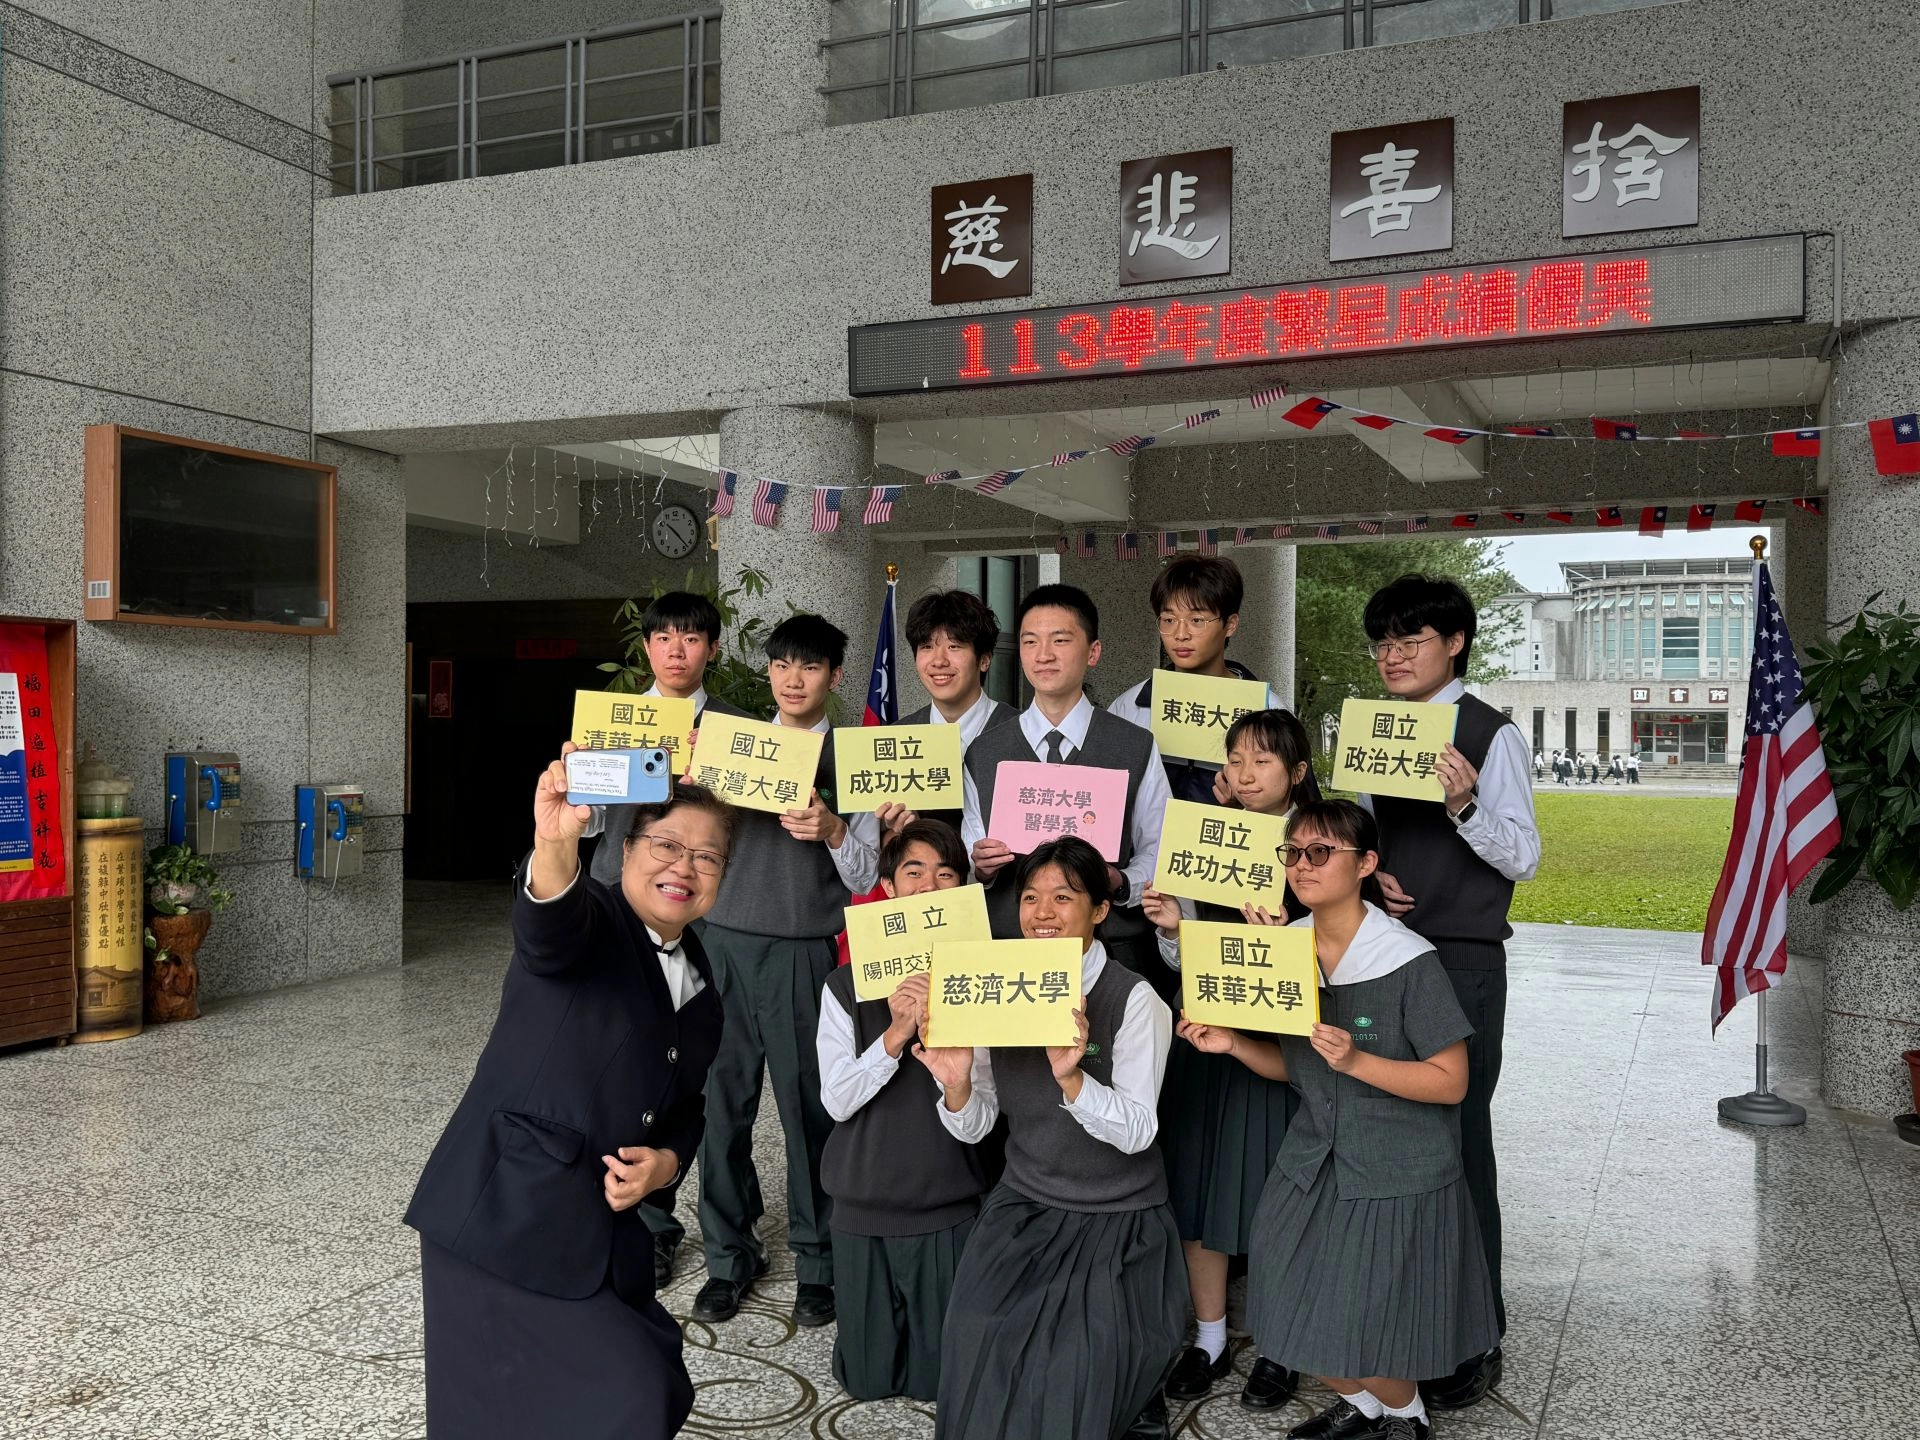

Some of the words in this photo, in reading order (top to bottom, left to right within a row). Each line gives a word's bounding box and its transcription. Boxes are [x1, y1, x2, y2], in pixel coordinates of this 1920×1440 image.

[611, 703, 658, 727] 國立
[1372, 713, 1418, 741] 國立
[730, 731, 782, 763] 國立
[873, 736, 924, 762] 國立
[1345, 746, 1438, 780] 政治大學
[697, 765, 800, 804] 臺灣大學
[849, 767, 951, 795] 成功大學
[1018, 786, 1092, 809] 慈濟大學
[1024, 812, 1078, 834] 醫學系
[1199, 818, 1251, 851] 國立
[1167, 850, 1273, 891] 成功大學
[883, 904, 948, 938] 國立
[1220, 937, 1273, 968] 國立
[942, 970, 1070, 1006] 慈濟大學
[1196, 973, 1303, 1011] 東華大學
